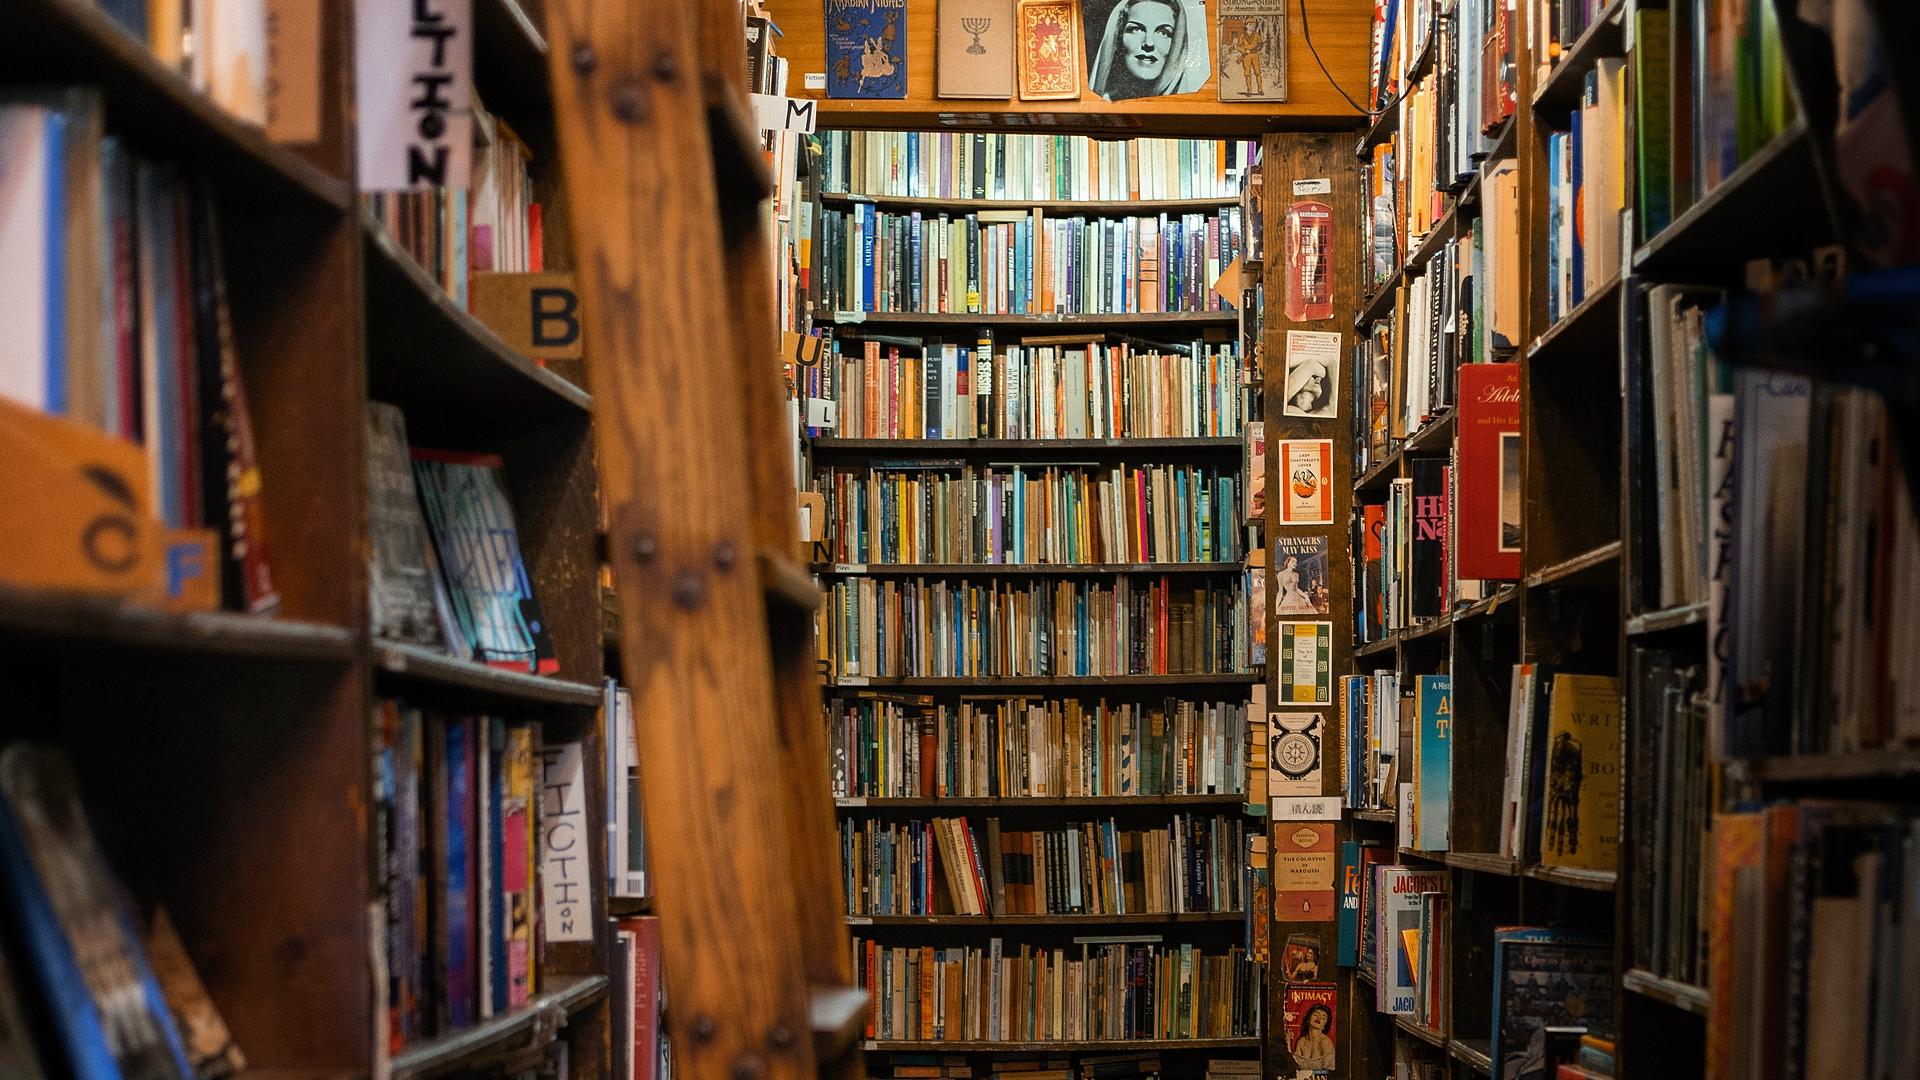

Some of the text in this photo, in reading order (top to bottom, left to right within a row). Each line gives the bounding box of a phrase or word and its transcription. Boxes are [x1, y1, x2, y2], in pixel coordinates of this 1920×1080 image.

[786, 100, 813, 132] M
[865, 236, 873, 267] Drama
[530, 288, 579, 347] B
[796, 335, 822, 366] U
[978, 346, 992, 395] THE SEASON
[823, 406, 831, 423] L
[814, 541, 833, 562] N
[1279, 536, 1321, 547] STRANGERS
[1282, 545, 1318, 555] MAY KISS
[166, 544, 202, 598] F
[1195, 859, 1204, 881] Complete
[1196, 882, 1204, 895] Plays
[1393, 875, 1437, 894] JACOB'S
[992, 945, 1000, 973] Strindberg
[1291, 992, 1333, 1002] INTIMACY
[1393, 996, 1414, 1012] JACO
